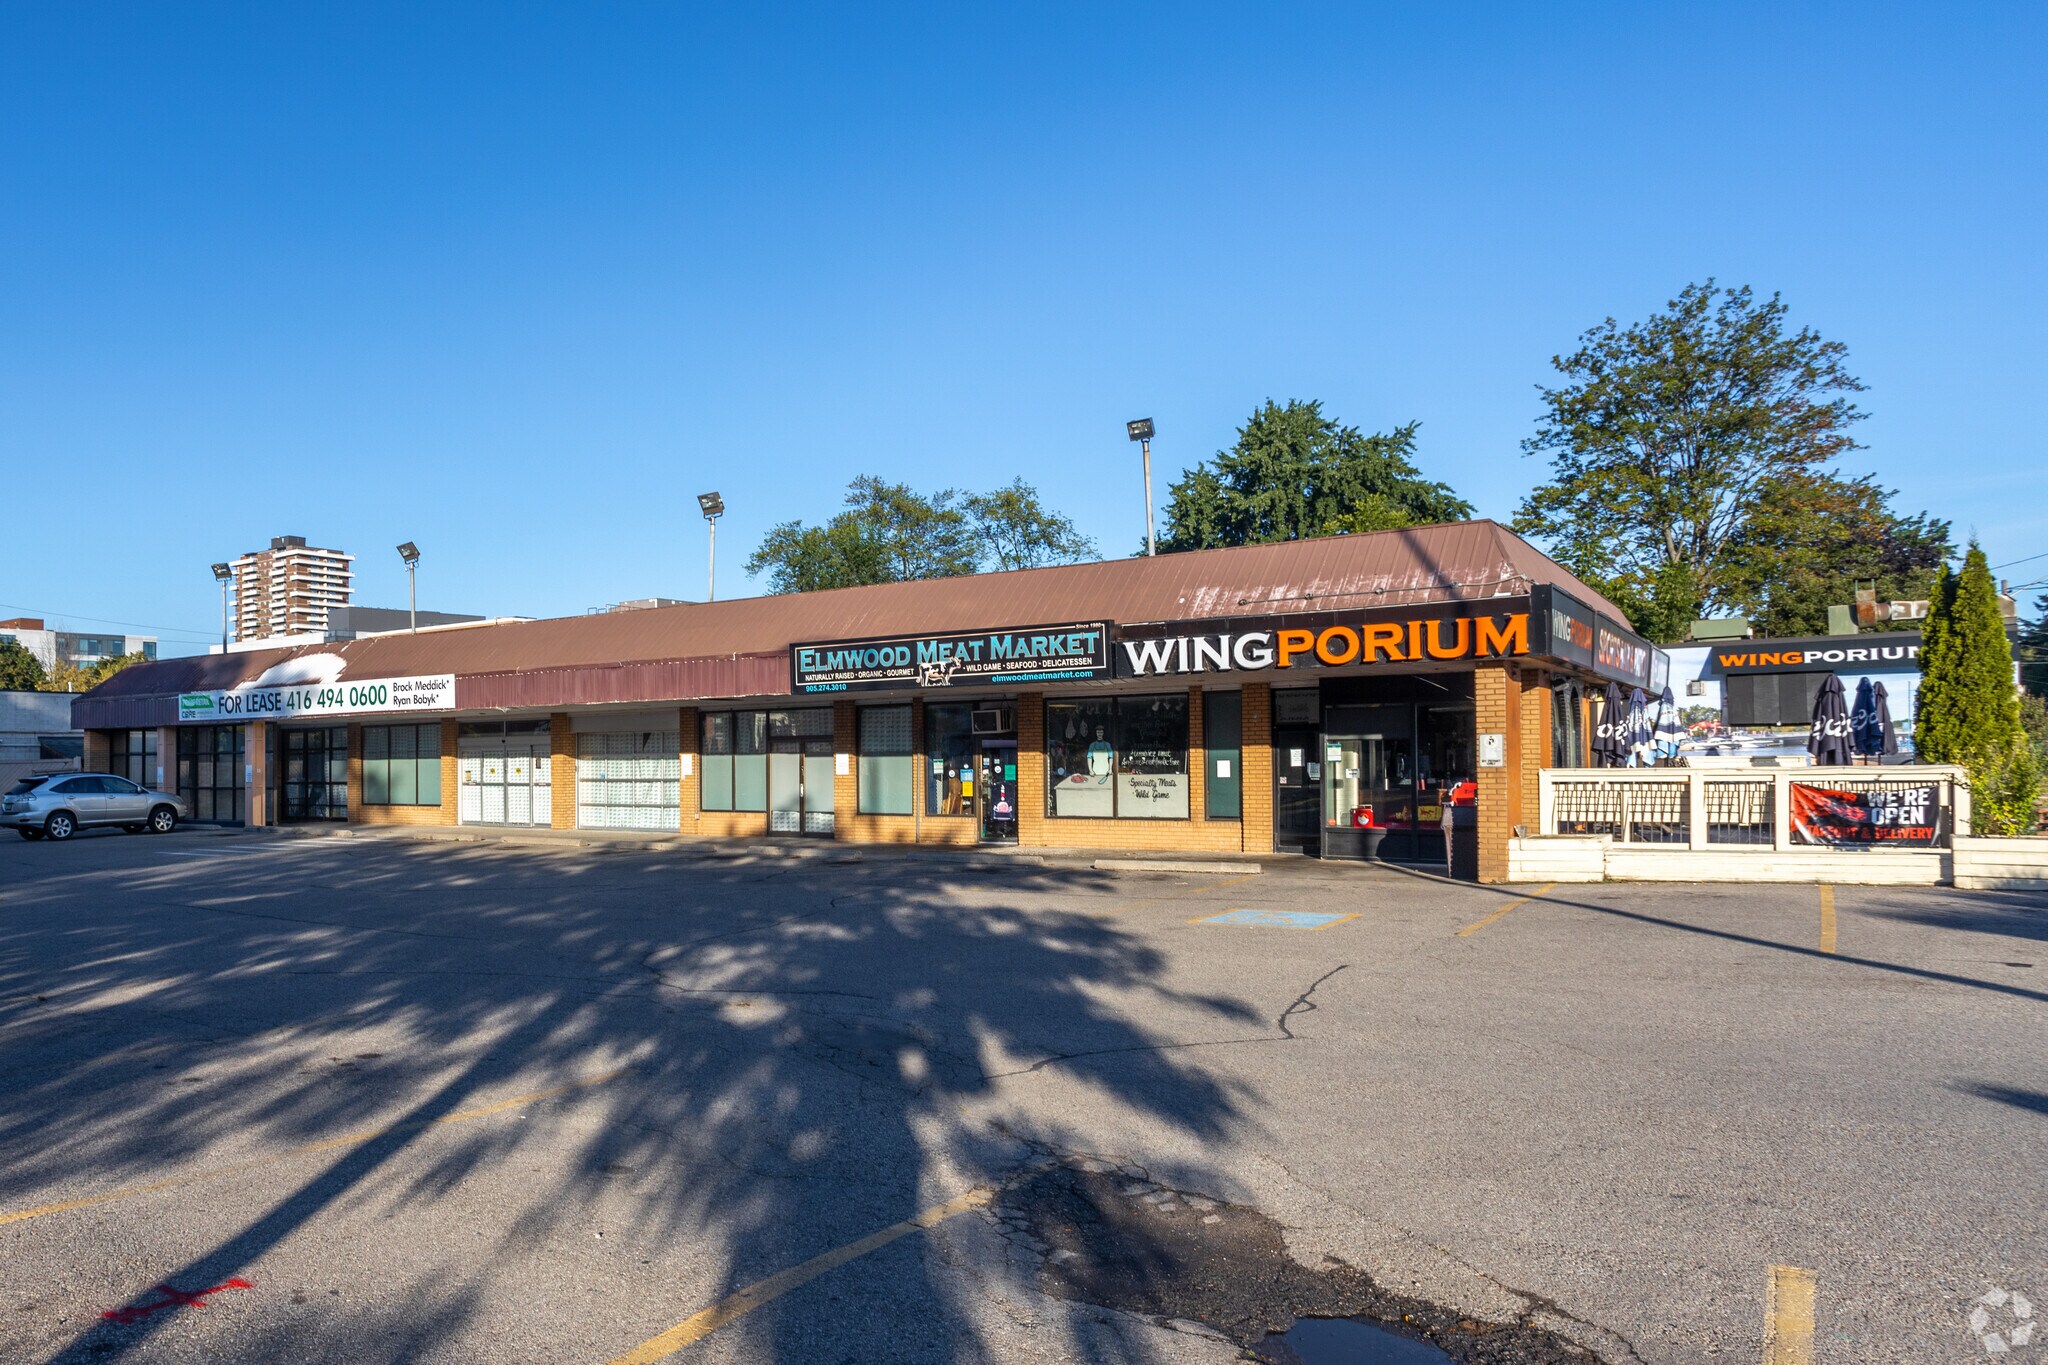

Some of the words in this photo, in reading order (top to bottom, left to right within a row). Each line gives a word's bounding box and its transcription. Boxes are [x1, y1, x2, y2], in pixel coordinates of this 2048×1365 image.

[1123, 613, 1530, 675] WINGPORIUM
[800, 646, 911, 673] ELMWOOD
[916, 640, 984, 665] MEAT
[990, 631, 1100, 660] MARKET
[966, 664, 982, 672] WILD
[983, 663, 1002, 671] GAME
[1006, 661, 1037, 670] SEAFOOD
[1042, 657, 1093, 668] DELICATESSEN
[805, 673, 835, 681] NATURALLY
[835, 672, 855, 680] RAISED
[858, 671, 883, 679] ORGANIC
[886, 668, 914, 677] GOURMET
[992, 670, 1093, 682] elmwoodmeatmarket.com
[393, 682, 413, 692] Brock
[805, 683, 847, 692] 905.274.3010
[218, 695, 242, 714] FOR
[246, 692, 282, 713] LEASE
[286, 690, 312, 710] 416
[317, 687, 344, 708] 494
[350, 684, 387, 706] 0600
[393, 696, 411, 707] Ryan
[1130, 777, 1157, 790] Specialty
[1158, 777, 1177, 788] Meats
[1135, 789, 1150, 799] Wild
[1152, 789, 1170, 803] Game
[1867, 788, 1931, 807] WE'RE
[1872, 806, 1925, 825] OPEN
[1861, 827, 1871, 838] &
[1875, 826, 1935, 839] DELIVERY
